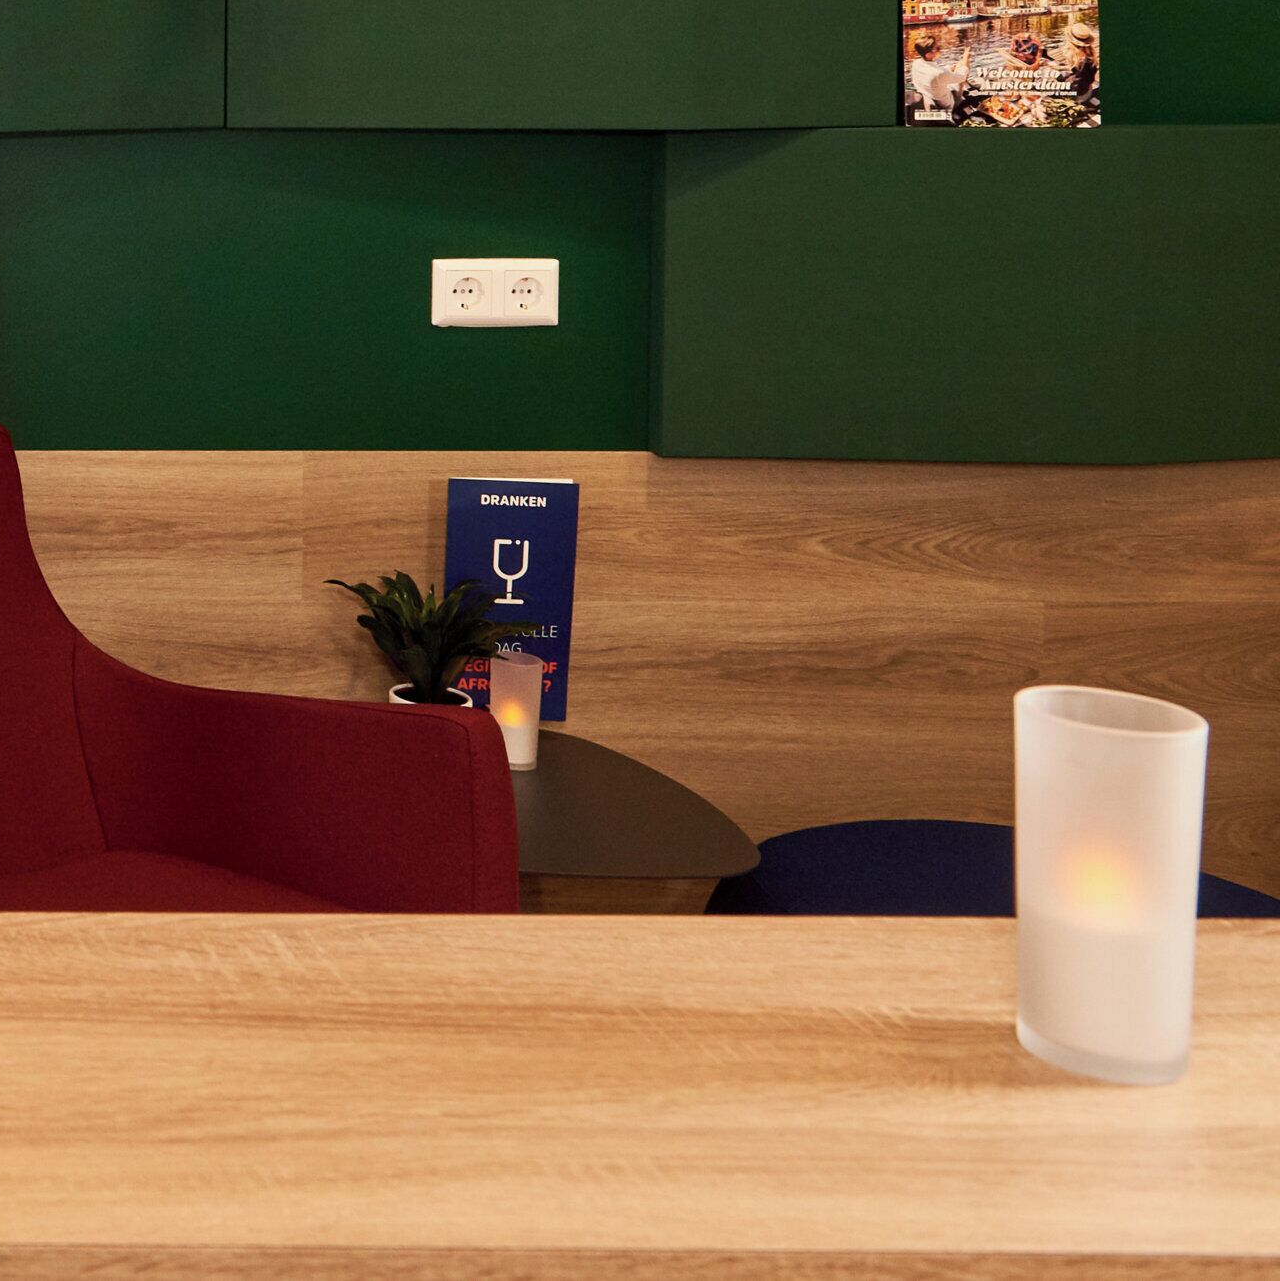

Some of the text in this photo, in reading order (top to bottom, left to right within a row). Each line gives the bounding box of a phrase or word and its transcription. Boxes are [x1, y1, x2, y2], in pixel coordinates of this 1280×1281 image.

[975, 66, 1060, 79] Welcome to
[980, 79, 1072, 91] Amsterdam
[480, 493, 547, 508] DRANKEN
